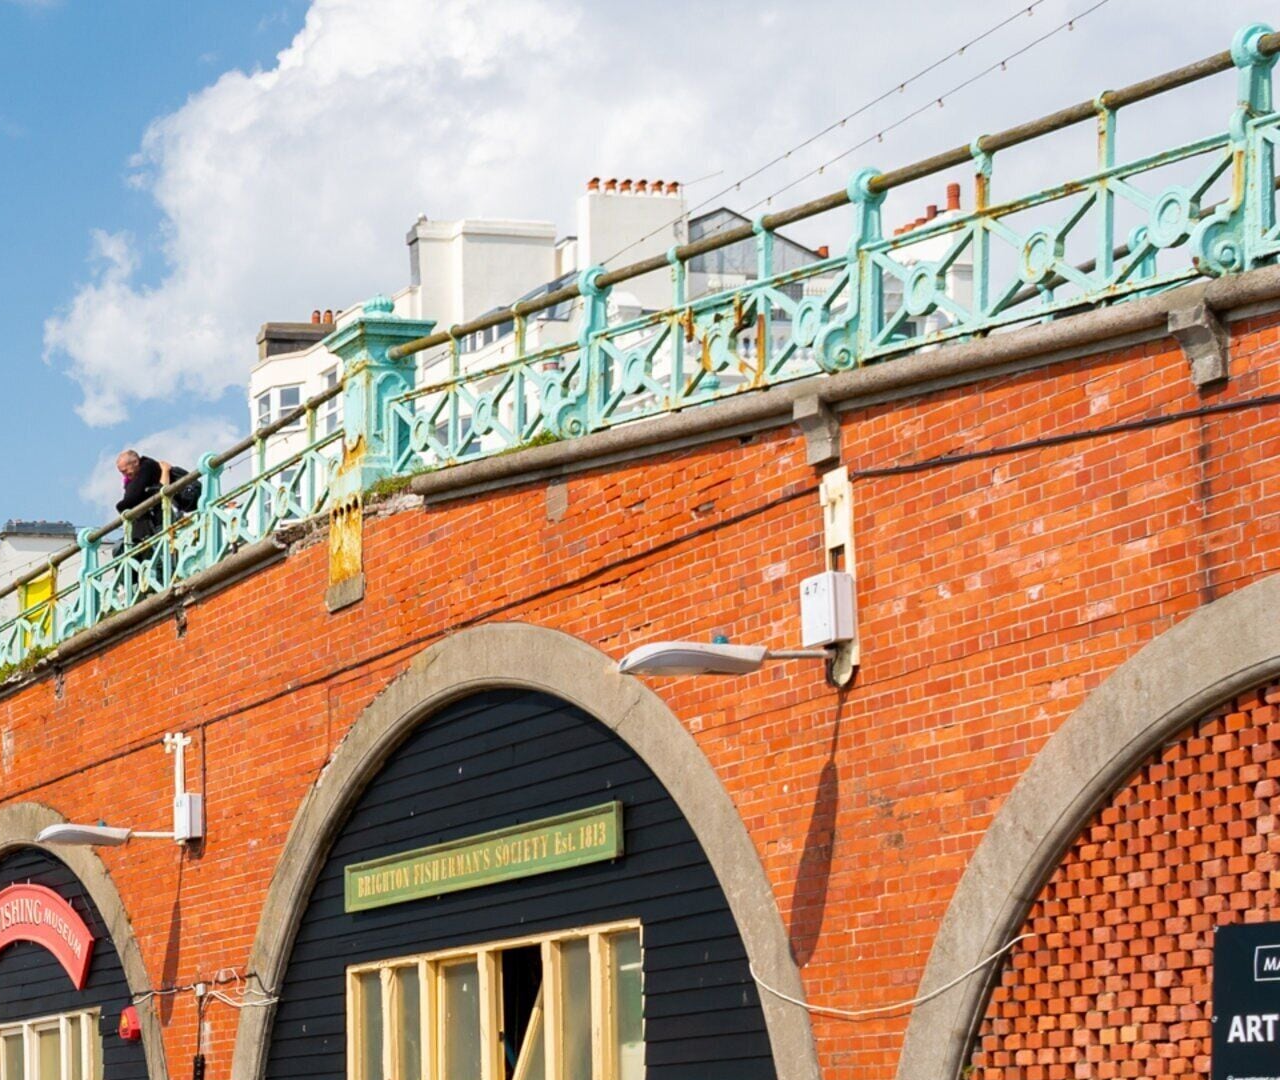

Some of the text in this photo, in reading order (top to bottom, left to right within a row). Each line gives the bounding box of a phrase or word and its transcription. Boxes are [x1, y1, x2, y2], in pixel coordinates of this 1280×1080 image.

[357, 821, 607, 898] BRIGHTON FISHERMAN'S SOCIETY Est. 1813
[43, 907, 82, 959] MUSEUM
[1227, 1013, 1279, 1043] ART
